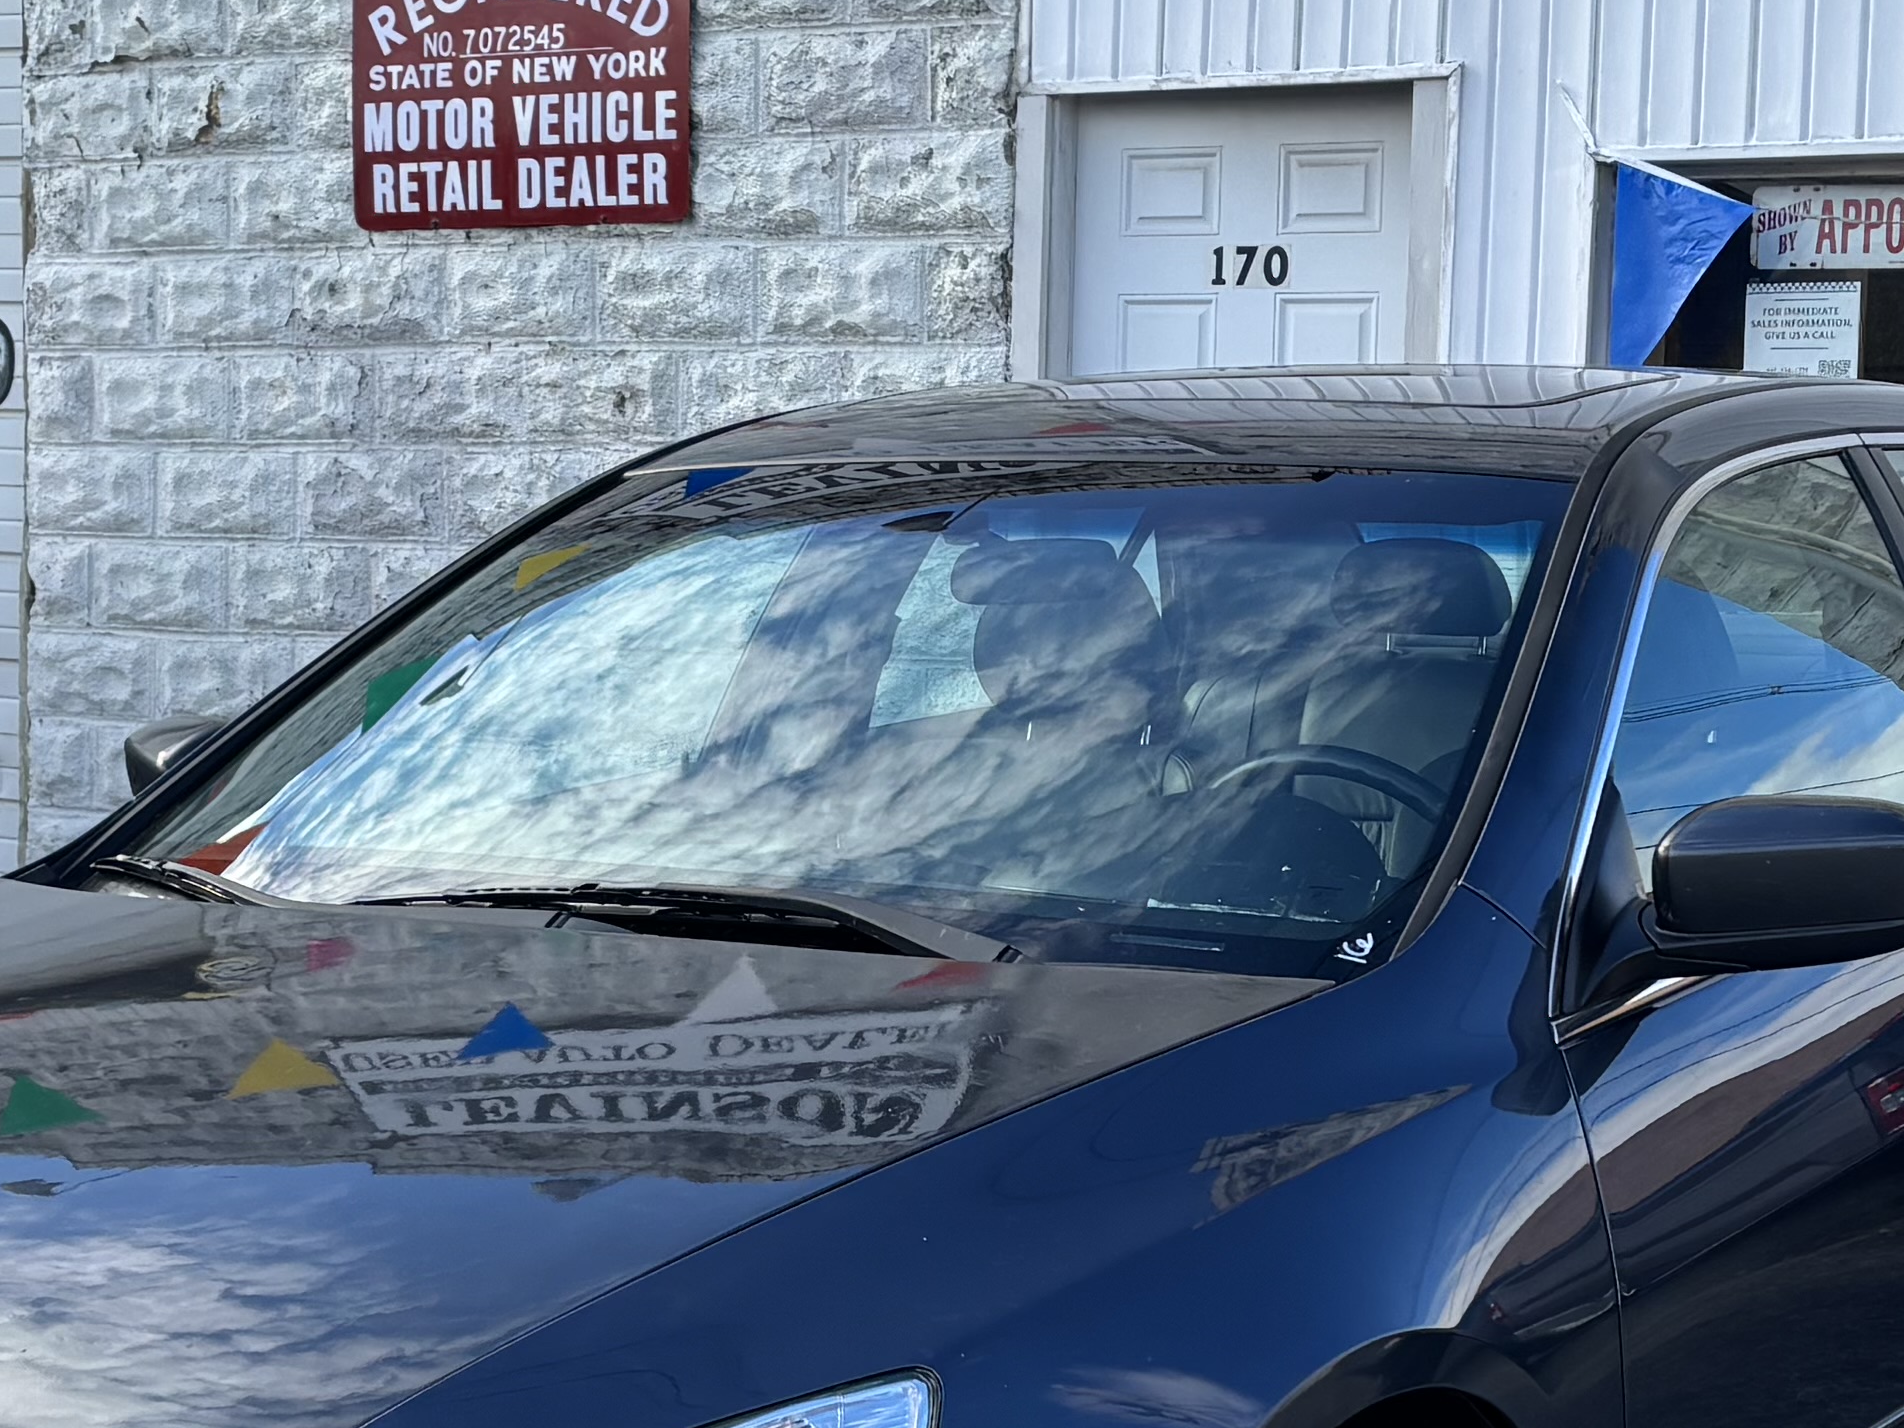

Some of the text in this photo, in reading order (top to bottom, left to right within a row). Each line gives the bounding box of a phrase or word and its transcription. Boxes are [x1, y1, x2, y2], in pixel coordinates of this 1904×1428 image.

[423, 24, 565, 58] NO. 7072545
[369, 47, 668, 92] STATE OF NEW YORK
[363, 90, 678, 153] MOTOR VEHICLE
[372, 153, 668, 214] RETAIL DEALER
[1756, 198, 1813, 234] SHOWN
[1778, 230, 1798, 256] BY
[1211, 245, 1289, 286] 170
[1750, 319, 1778, 328] SALES
[1764, 331, 1786, 340] GIVE
[1789, 331, 1801, 340] US
[1812, 330, 1836, 340] CALL
